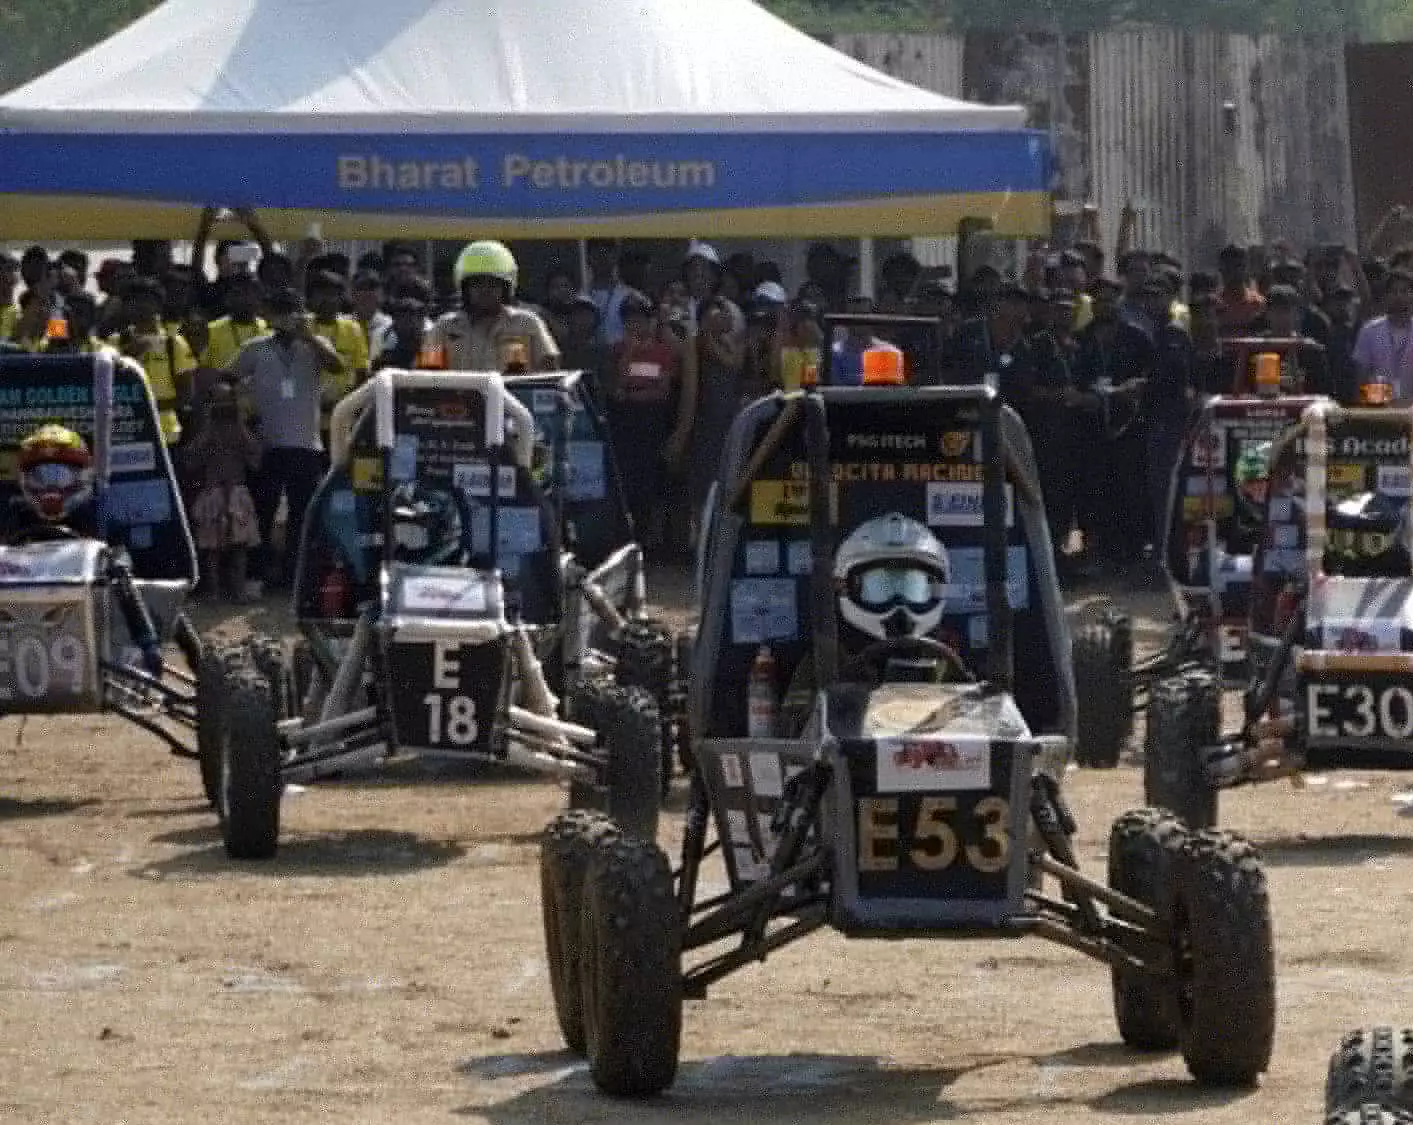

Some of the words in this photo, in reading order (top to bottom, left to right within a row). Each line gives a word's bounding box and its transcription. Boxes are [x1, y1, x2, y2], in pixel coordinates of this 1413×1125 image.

[337, 152, 478, 190] Bharat
[502, 152, 716, 189] Petroleum
[434, 640, 462, 690] E
[423, 693, 479, 746] 18
[858, 796, 1012, 874] E53
